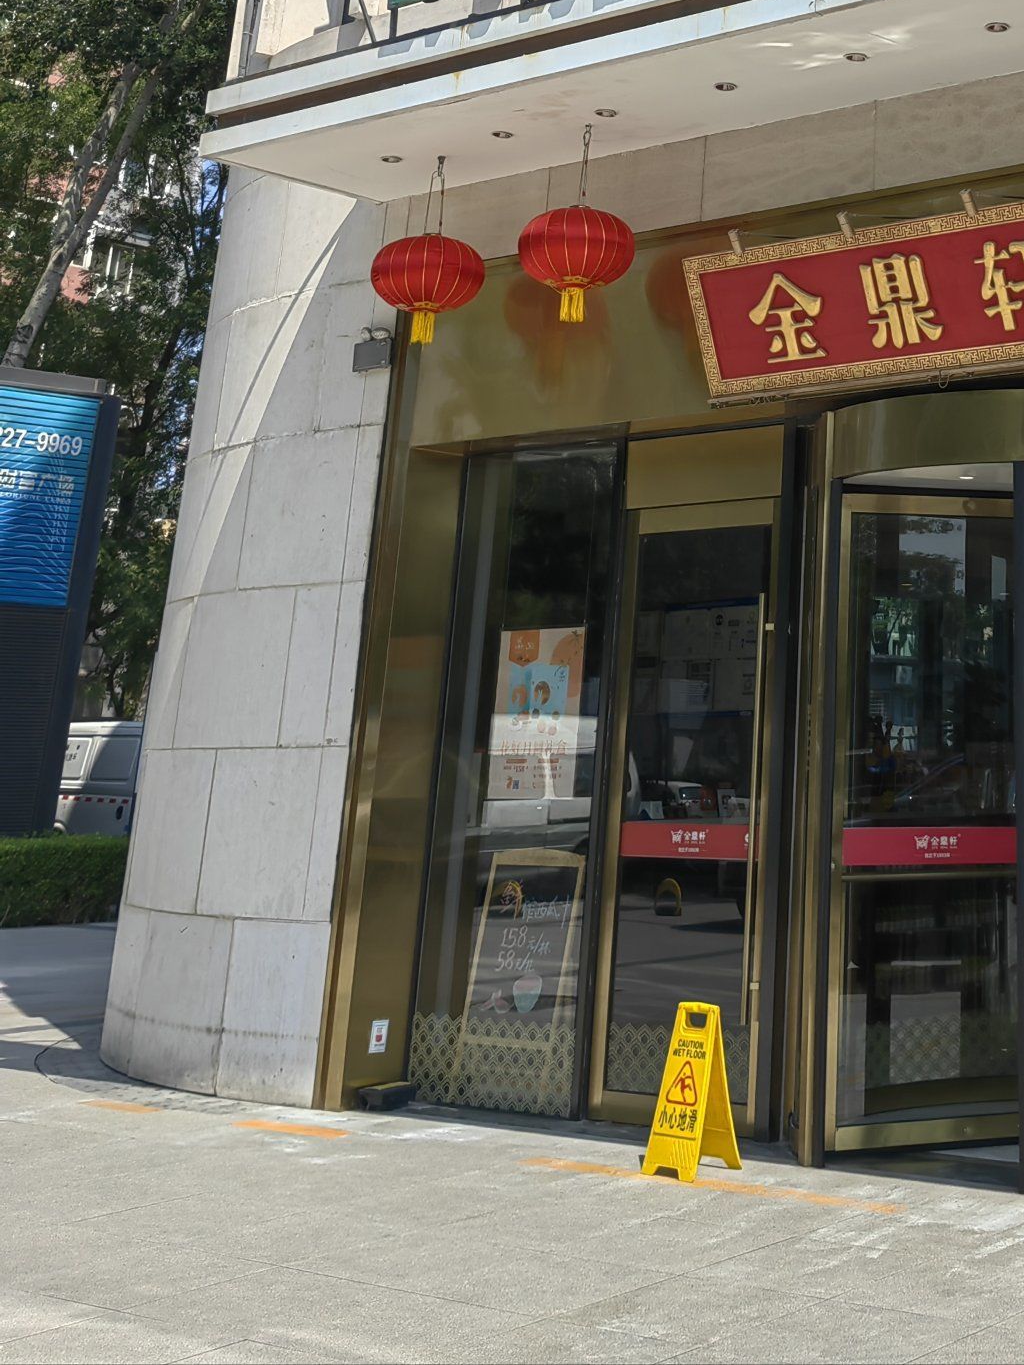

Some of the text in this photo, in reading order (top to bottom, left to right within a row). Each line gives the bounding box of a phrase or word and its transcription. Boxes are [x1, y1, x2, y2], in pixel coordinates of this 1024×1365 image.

[677, 1038, 704, 1050] CAUTION
[672, 1048, 707, 1060] WET FLOOR
[658, 1105, 698, 1133] 小心地滑
